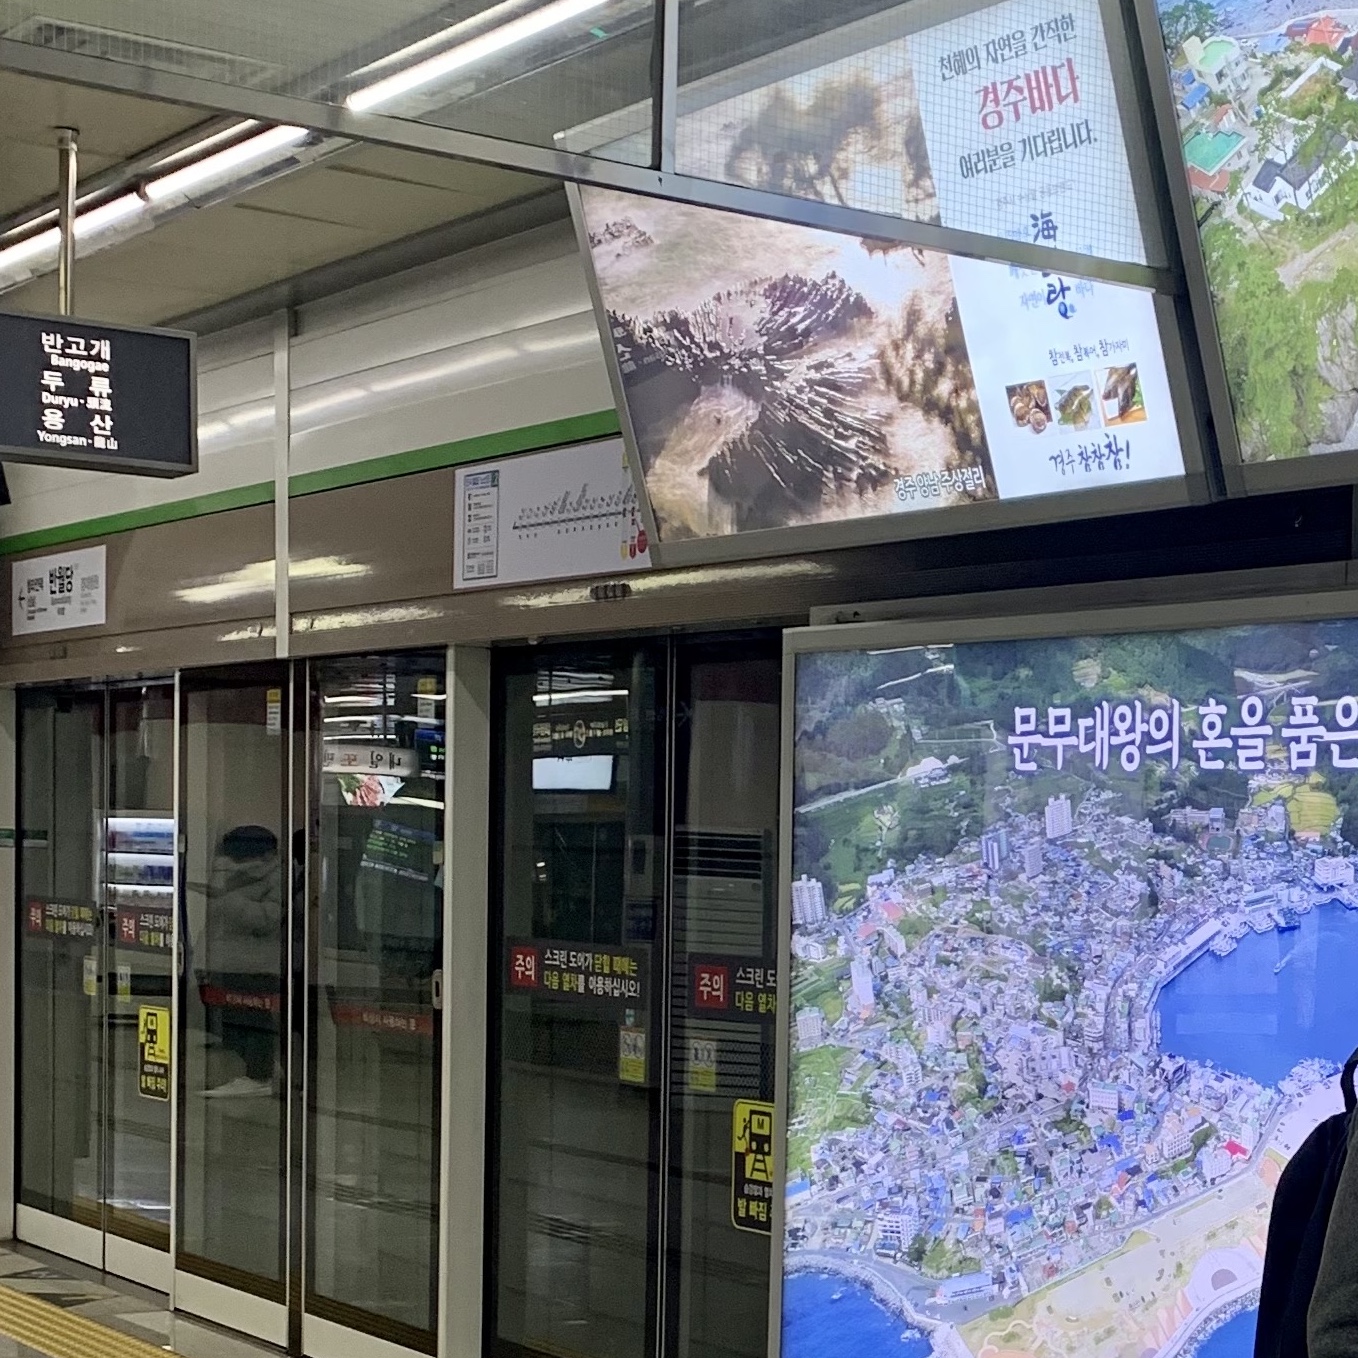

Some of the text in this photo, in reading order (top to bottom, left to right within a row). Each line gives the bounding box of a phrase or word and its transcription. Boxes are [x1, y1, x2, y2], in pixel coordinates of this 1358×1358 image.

[938, 13, 1077, 81] 천혜의 자연을 간직한
[975, 57, 1080, 130] 경주바다
[959, 119, 1098, 179] 여러분을 기다립니다.
[41, 332, 111, 361] 반고개
[50, 354, 110, 373] Bangogae
[37, 430, 87, 447] Yongsan
[893, 465, 986, 501] 경주 양남 주상절리
[1008, 699, 1180, 772] 문무대왕의
[1193, 697, 1273, 771] 혼을
[514, 954, 535, 981] 주의
[544, 949, 568, 969] 스크린
[544, 970, 560, 990] 다음
[699, 973, 724, 1002] 주의
[735, 966, 764, 988] 스크린
[735, 991, 754, 1012] 다음
